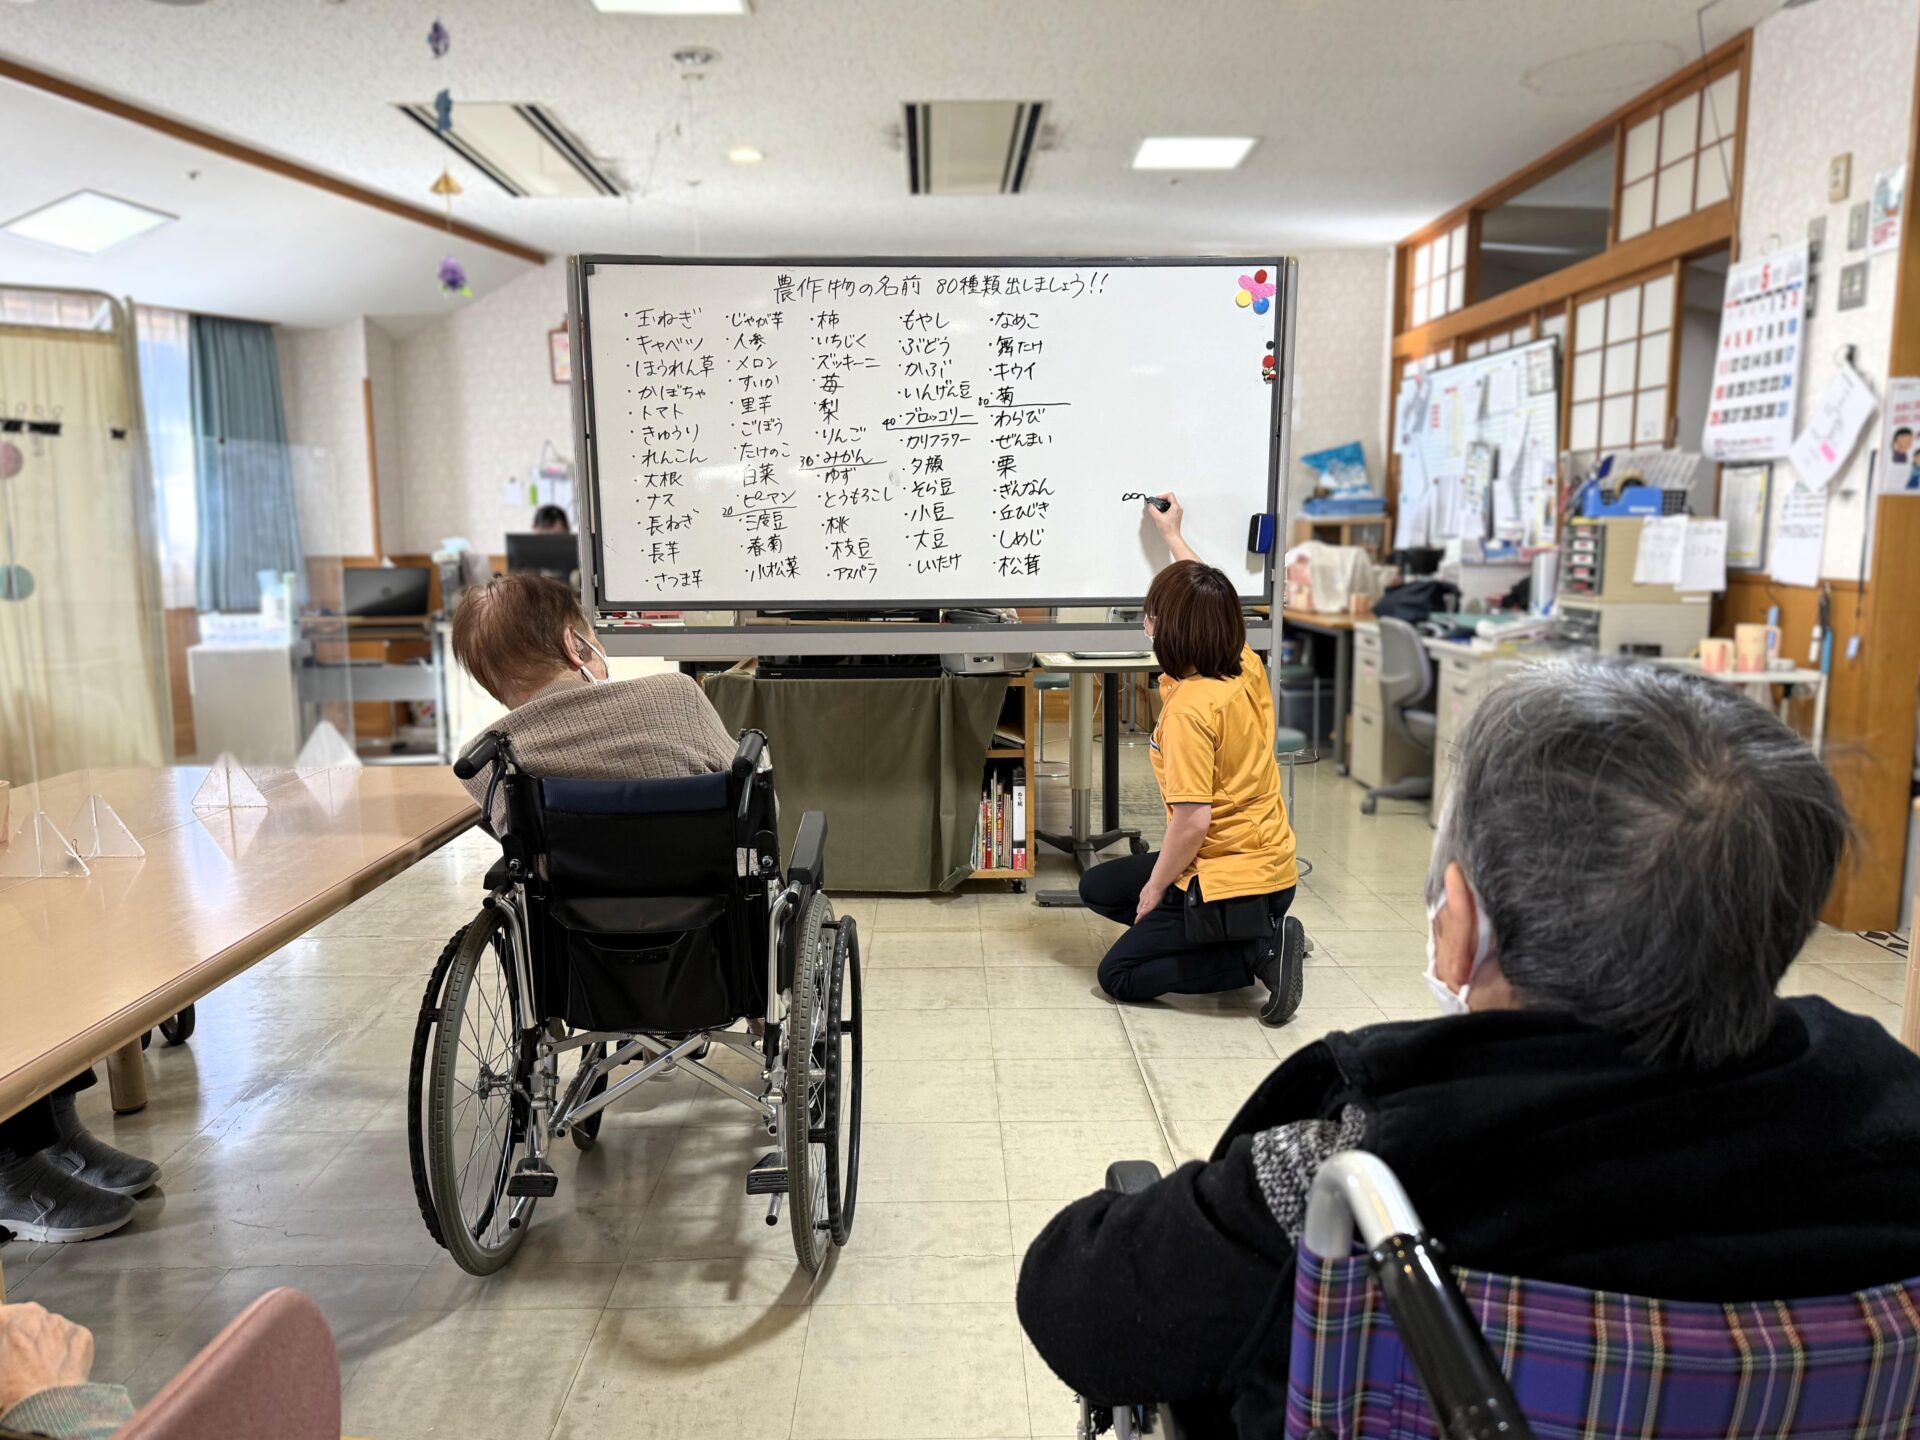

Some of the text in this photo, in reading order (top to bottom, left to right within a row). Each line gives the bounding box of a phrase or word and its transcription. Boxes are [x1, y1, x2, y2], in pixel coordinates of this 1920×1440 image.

[772, 273, 922, 305] 農作物の名前
[635, 306, 702, 330] 玉ねぎ
[731, 310, 784, 331] じゃが芋
[816, 309, 840, 331] 柿
[903, 308, 950, 332] もやし
[994, 311, 1040, 331] なめこ
[636, 335, 704, 356] キャベツ
[817, 333, 867, 349] いちじく
[903, 335, 950, 357] ぶどう
[635, 354, 715, 378] ほうれん草
[735, 355, 778, 371] メロン
[816, 352, 881, 372] ズッキーニ
[904, 358, 952, 379] かぶ
[993, 361, 1037, 382] キウイ
[637, 383, 707, 401] かぼちゃ
[738, 374, 780, 393] すいか
[904, 378, 973, 402] いんげん豆
[740, 394, 773, 416] 里芋
[995, 386, 1015, 407] 菊
[642, 402, 684, 421] トマト
[818, 397, 840, 426] 梨
[881, 417, 896, 427] 40
[905, 406, 975, 426] ブロッコリー
[993, 407, 1046, 428] わらび
[641, 423, 699, 446] きゅうり
[741, 417, 783, 437] ごぼう
[822, 425, 867, 446] りんご
[906, 432, 971, 450] カリフラワー
[994, 431, 1052, 450] ぜんまい
[641, 447, 708, 468] れんこん
[739, 441, 791, 462] たけのこ
[823, 447, 874, 466] みかん
[743, 462, 780, 488] 白菜
[824, 466, 857, 486] ゆず
[996, 454, 1017, 480] 栗
[643, 471, 684, 488] 大根
[911, 477, 956, 498] そら豆
[999, 477, 1056, 500] ぎんなん
[646, 492, 675, 511] ナス
[743, 489, 797, 508] ピーマン
[824, 486, 893, 509] とうもろこし
[745, 510, 788, 531] 三度豆
[910, 501, 955, 523] 小豆
[999, 501, 1050, 522] 丘ひじき
[645, 508, 700, 537] 長ねぎ
[825, 515, 850, 535] 桃
[746, 533, 783, 557] 春菊
[913, 527, 949, 551] 大豆
[999, 527, 1045, 549] しめじ
[830, 537, 873, 561] 枝豆
[832, 562, 878, 584] アスパラ
[917, 552, 963, 575] しいたけ
